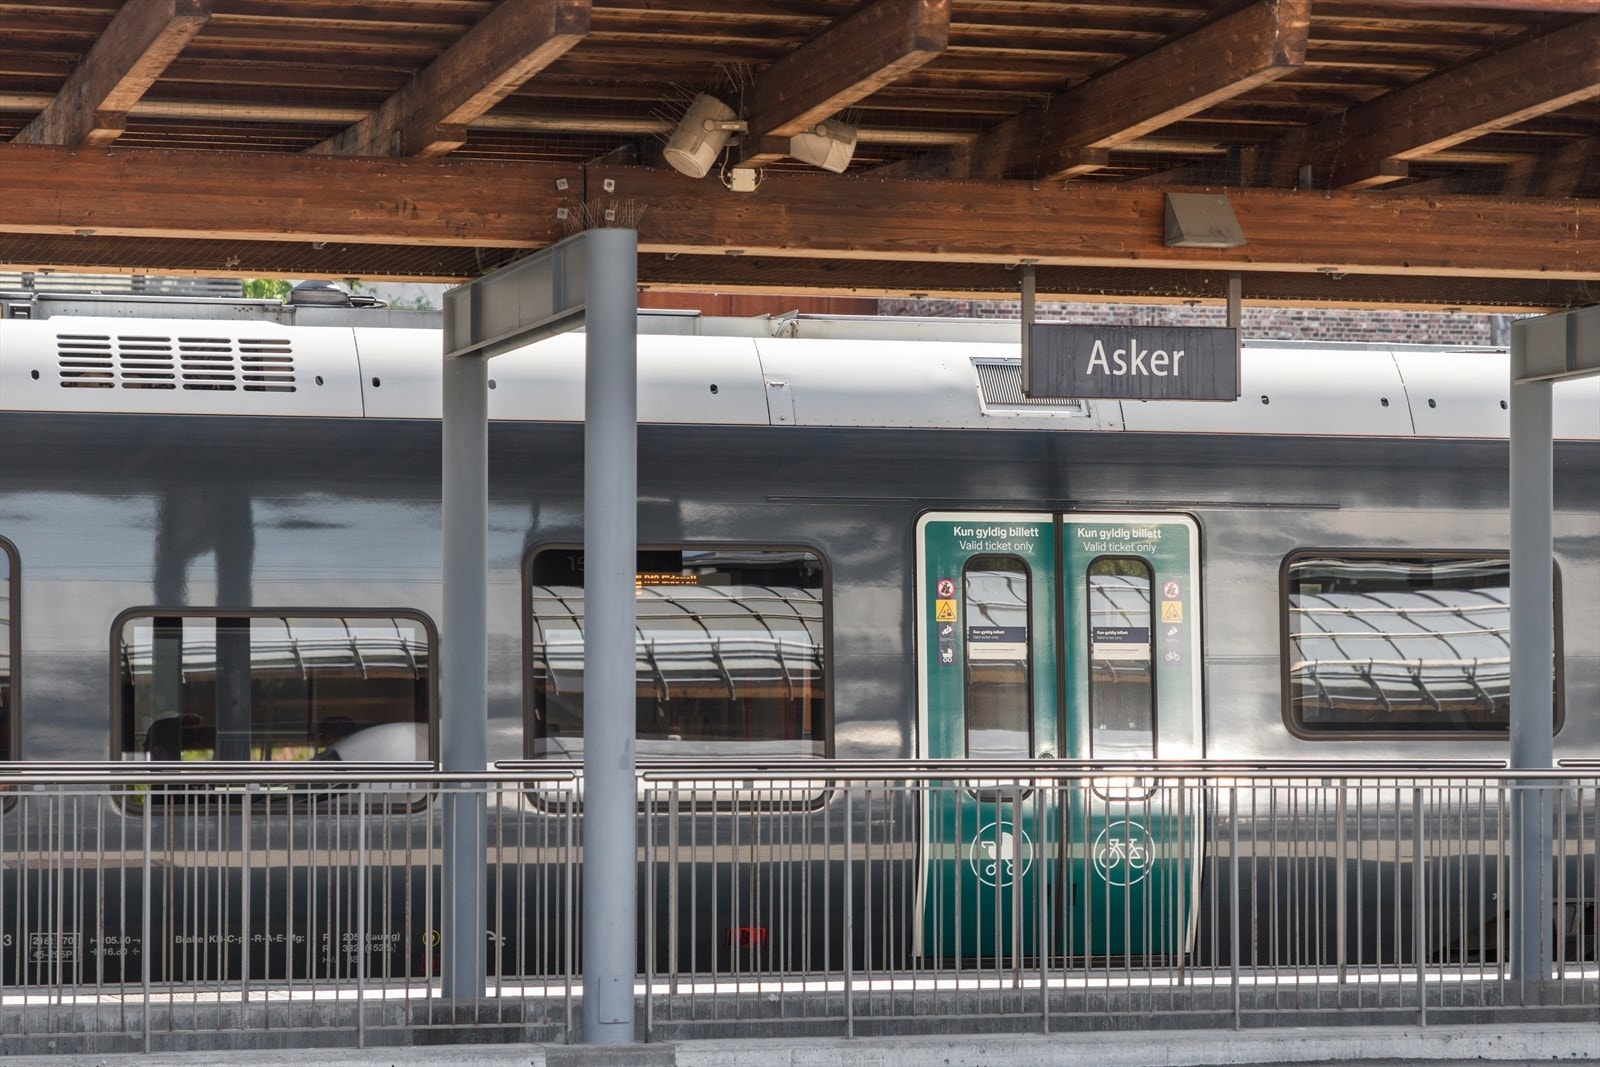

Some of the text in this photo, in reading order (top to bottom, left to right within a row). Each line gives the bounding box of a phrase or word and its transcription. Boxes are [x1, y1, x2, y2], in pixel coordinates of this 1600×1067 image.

[1086, 339, 1184, 376] Asker
[953, 526, 1039, 539] Kun gyldig billett
[1077, 528, 1162, 540] Kun gyldig billett
[959, 540, 1034, 553] Valid ticket only
[1083, 541, 1157, 554] Valid ticket only
